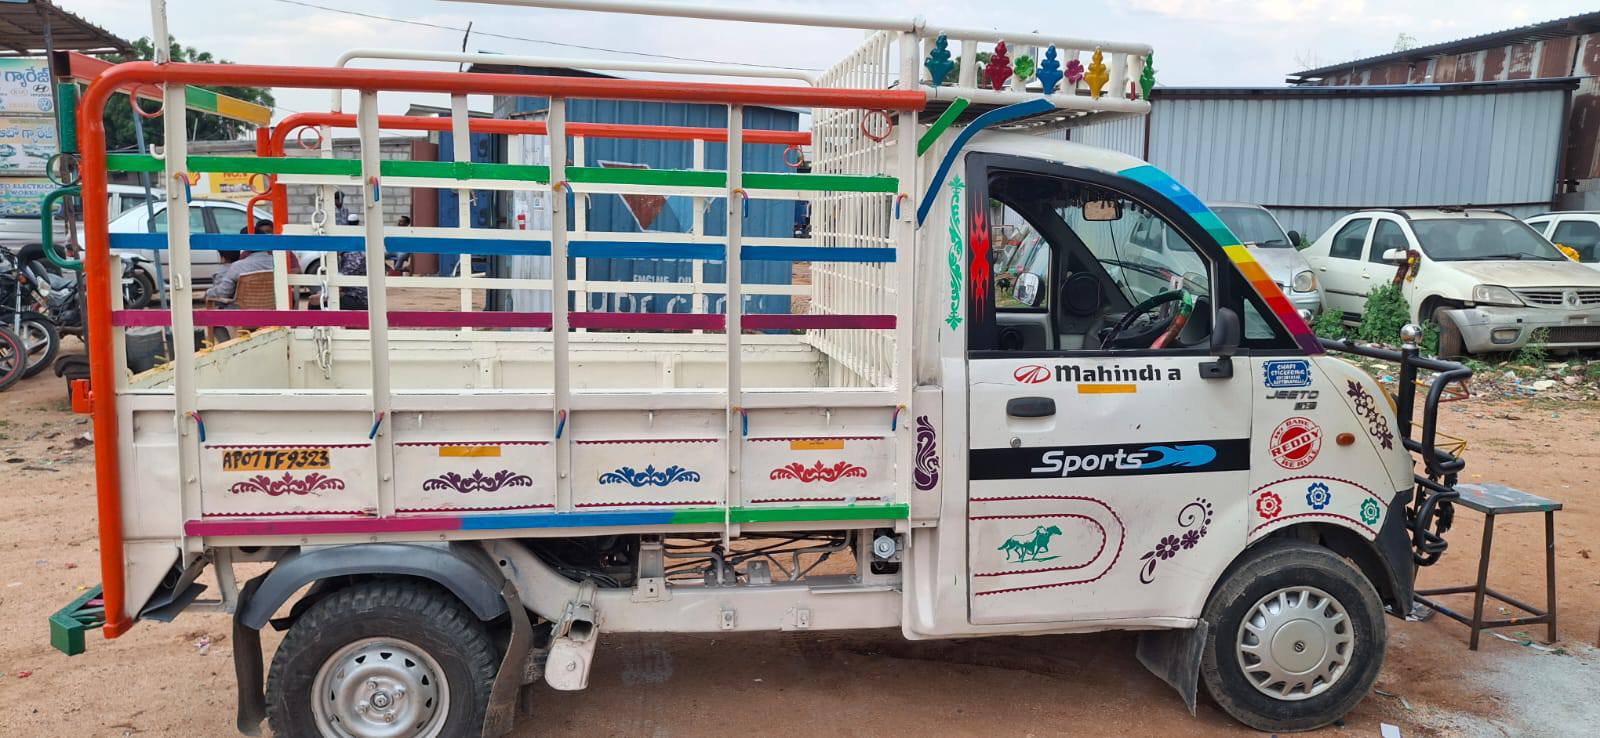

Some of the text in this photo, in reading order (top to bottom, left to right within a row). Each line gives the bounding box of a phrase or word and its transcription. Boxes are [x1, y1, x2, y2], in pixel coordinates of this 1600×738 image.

[1266, 390, 1319, 399] JEETO
[1271, 431, 1318, 457] REDDY
[1031, 448, 1149, 477] Sports
